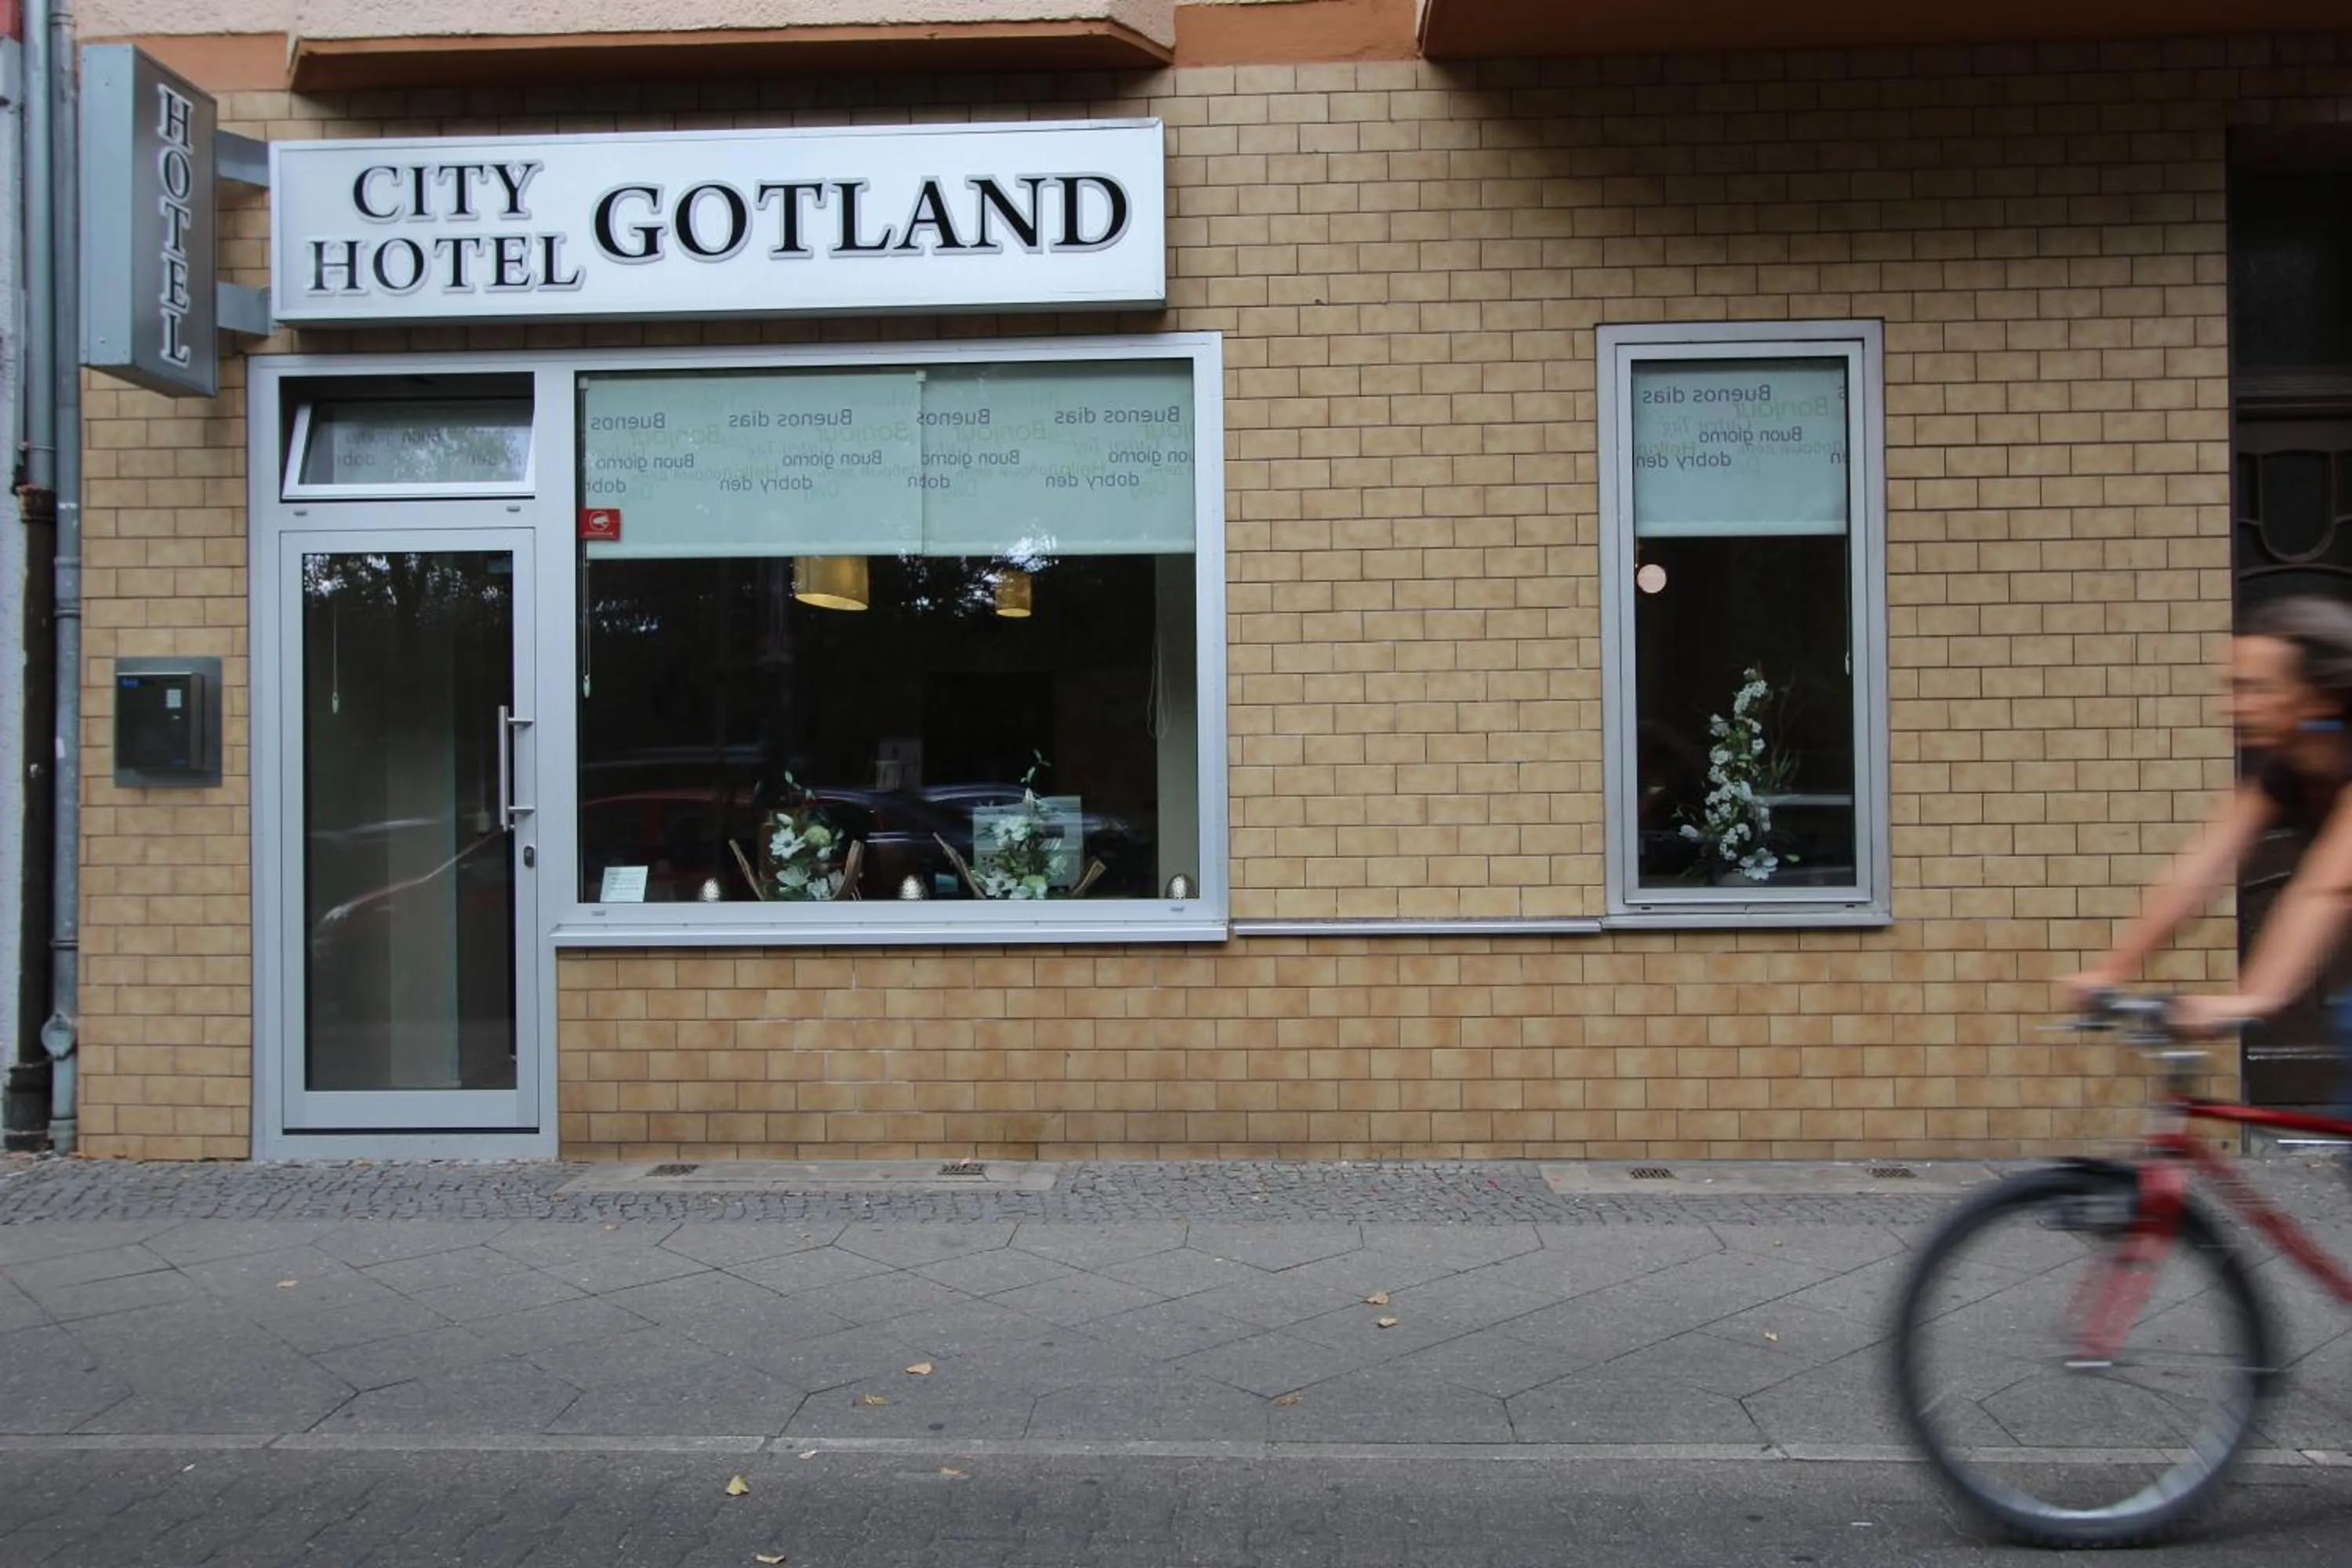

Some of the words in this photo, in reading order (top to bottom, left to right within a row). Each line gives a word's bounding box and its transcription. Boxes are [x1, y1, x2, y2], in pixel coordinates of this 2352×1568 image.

[159, 86, 191, 366] HOTEL
[352, 161, 541, 221] CITY
[593, 174, 1129, 261] GOTLAND
[310, 234, 584, 294] HOTEL
